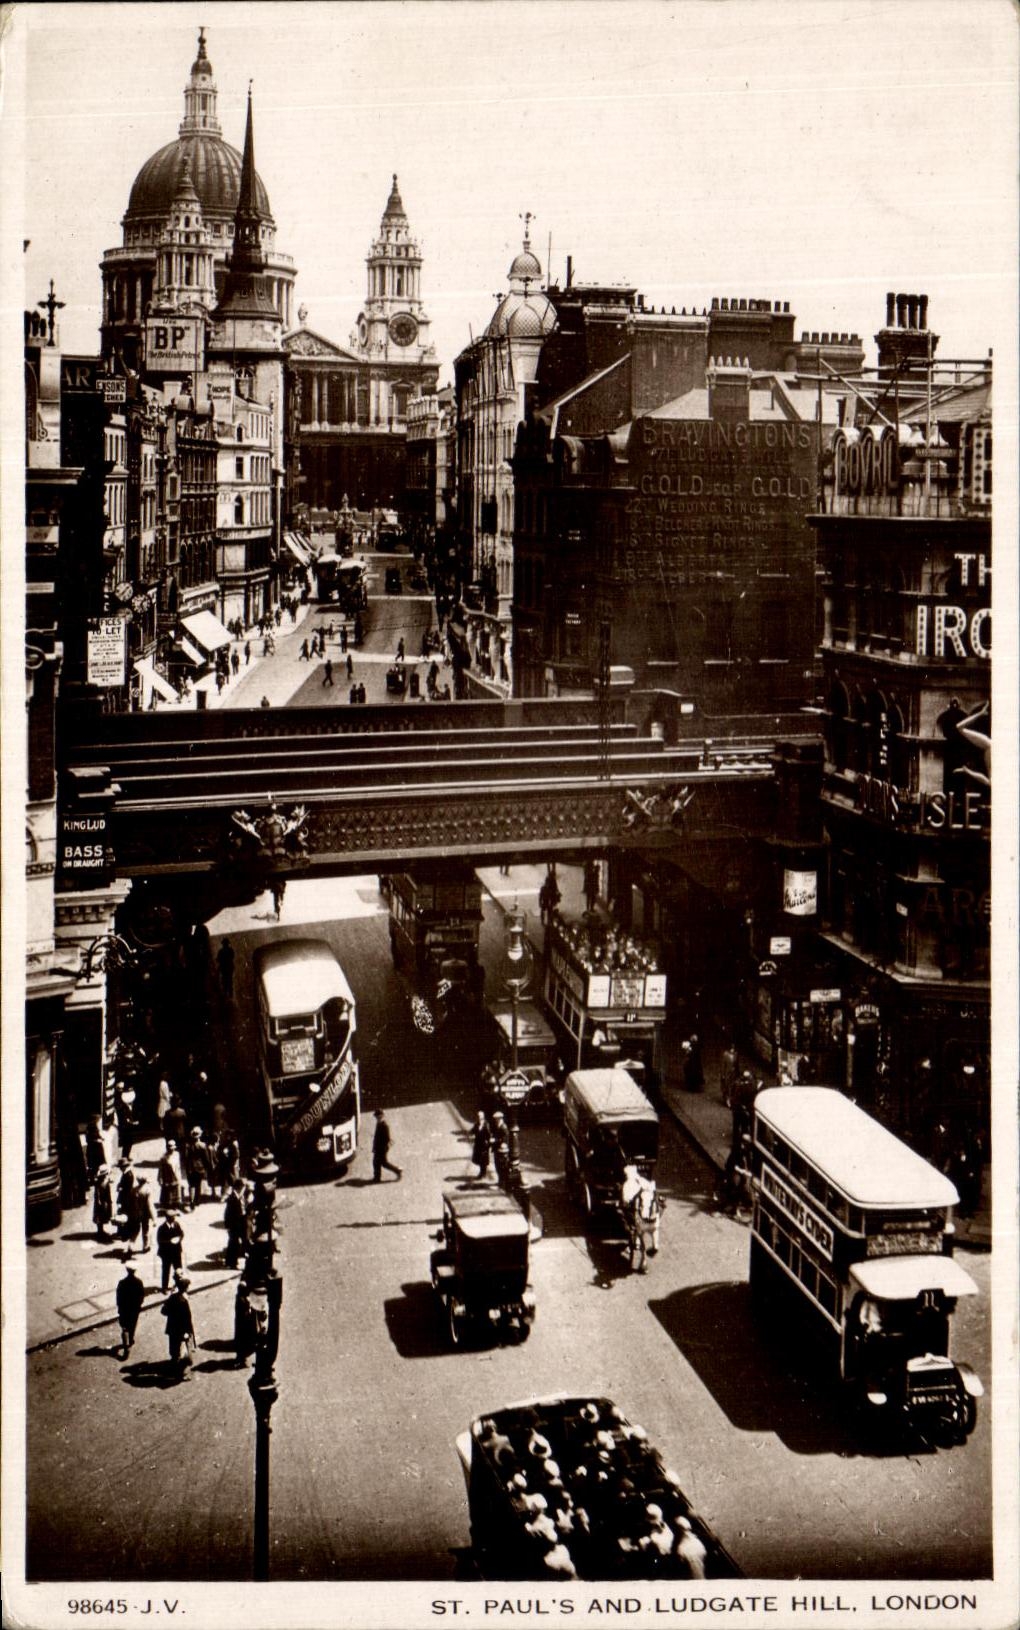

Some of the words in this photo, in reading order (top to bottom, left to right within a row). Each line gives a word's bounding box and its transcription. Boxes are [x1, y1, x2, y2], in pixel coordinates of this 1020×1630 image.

[642, 419, 812, 448] BRAVINGTONS
[834, 435, 899, 492] BOVRIL
[641, 474, 705, 497] GOLD
[750, 476, 811, 499] GOLD
[656, 497, 717, 513] WEDDING
[723, 497, 766, 514] RINGS
[106, 626, 122, 636] LET
[919, 790, 982, 829] ISLE
[63, 820, 86, 831] KING
[86, 818, 106, 831] LUD
[64, 844, 104, 859] BASS
[73, 857, 105, 869] DRAUGHT
